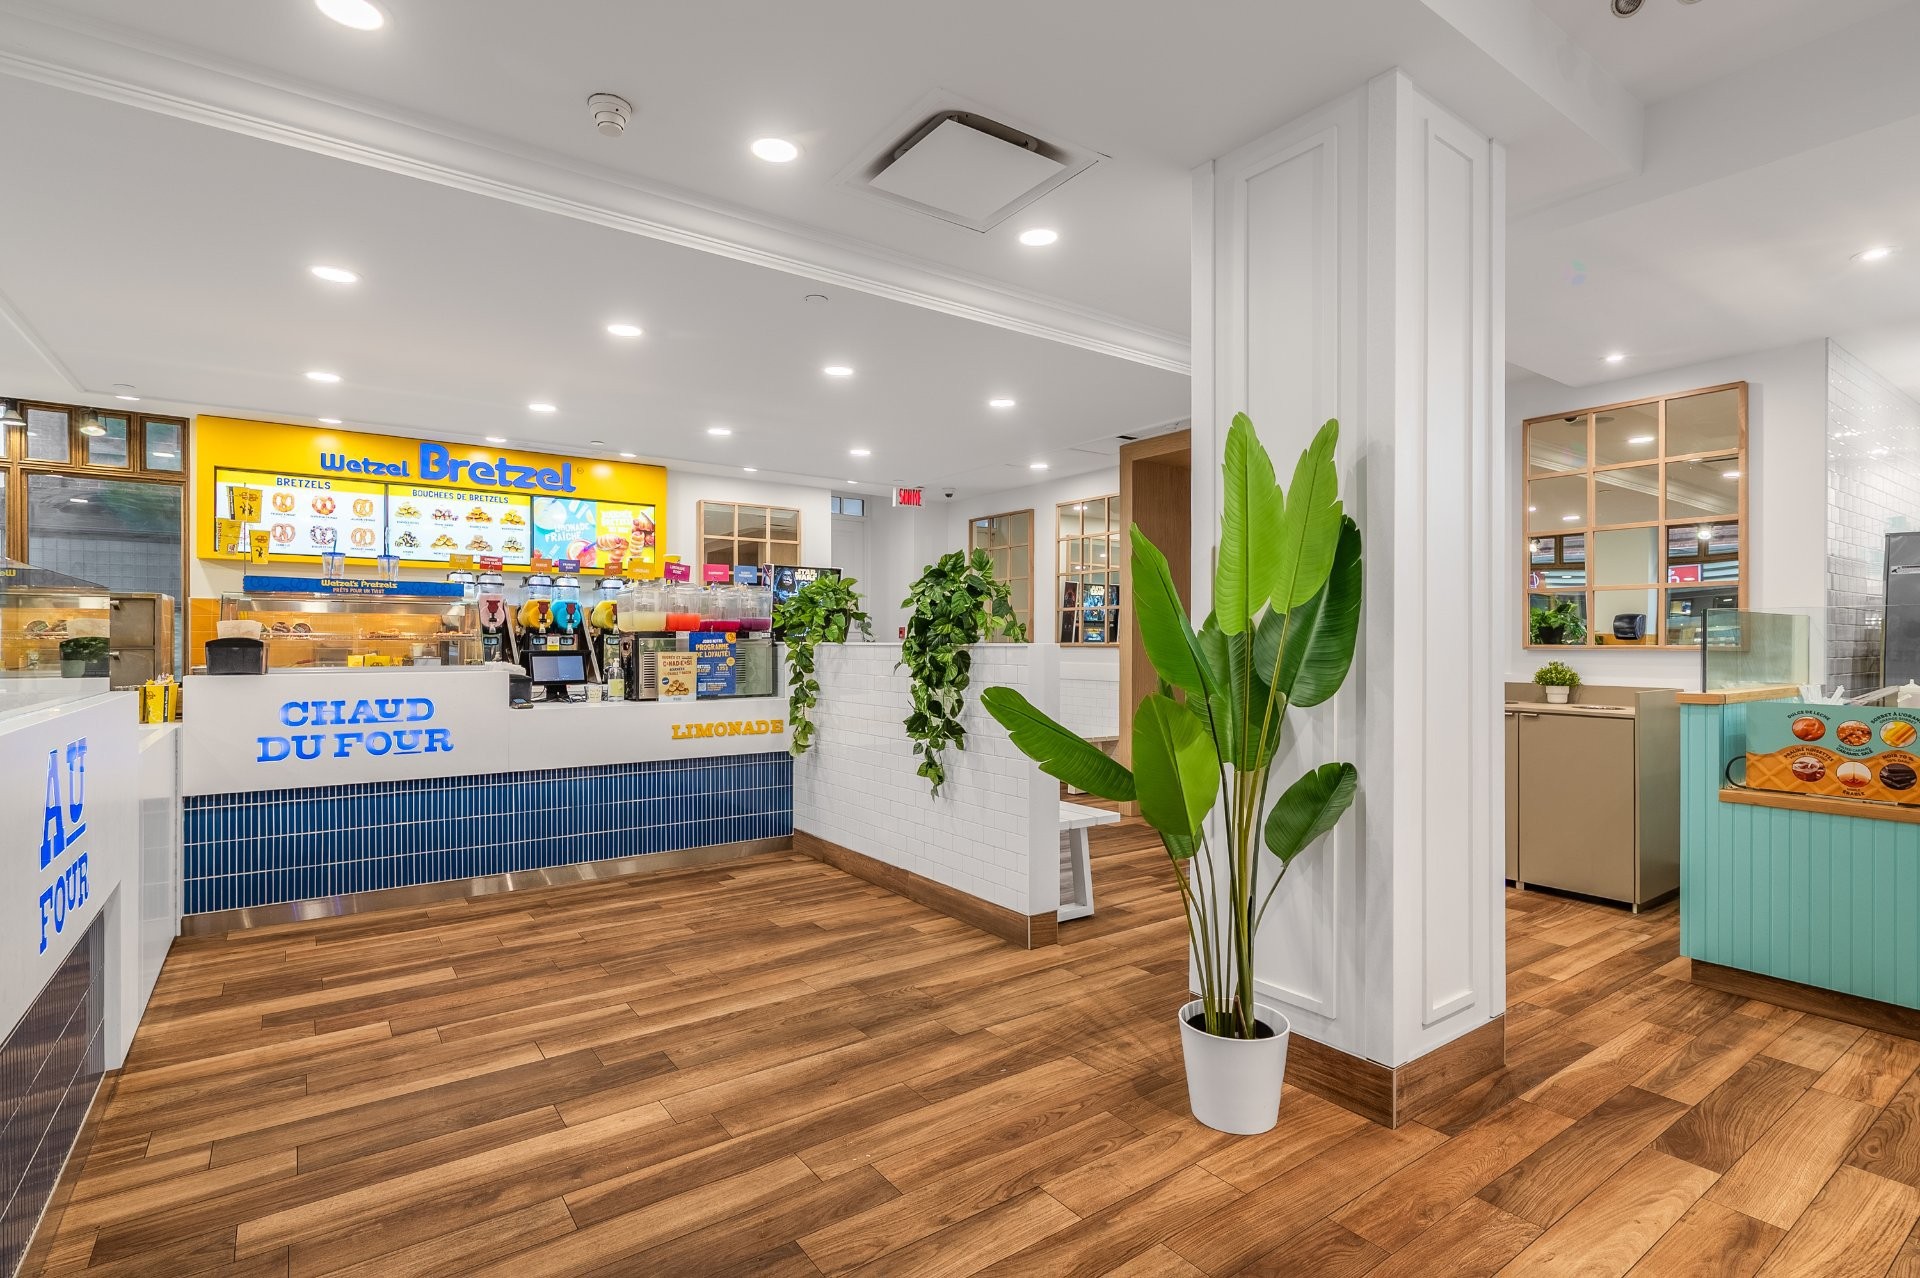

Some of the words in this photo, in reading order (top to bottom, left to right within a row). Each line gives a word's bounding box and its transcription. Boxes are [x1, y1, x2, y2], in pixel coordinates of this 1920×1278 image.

[320, 452, 410, 477] Wetzel
[419, 442, 576, 493] Bretzel
[276, 477, 331, 490] BRETZELS
[456, 492, 466, 501] DE
[469, 494, 509, 504] BRETZELS
[899, 488, 922, 506] SORTIE
[321, 579, 359, 588] Wetzel's
[360, 580, 398, 589] Pretzels
[279, 697, 436, 727] CHAUD
[1787, 710, 1804, 719] DULCE
[1813, 710, 1831, 721] LECHE
[1870, 712, 1892, 724] SORBET
[1898, 712, 1920, 725] L'ORAN
[671, 719, 784, 739] LIMONADE
[256, 734, 326, 762] DU
[333, 728, 455, 758] FOUR
[39, 736, 88, 872] AU
[39, 851, 89, 956] FOUR
